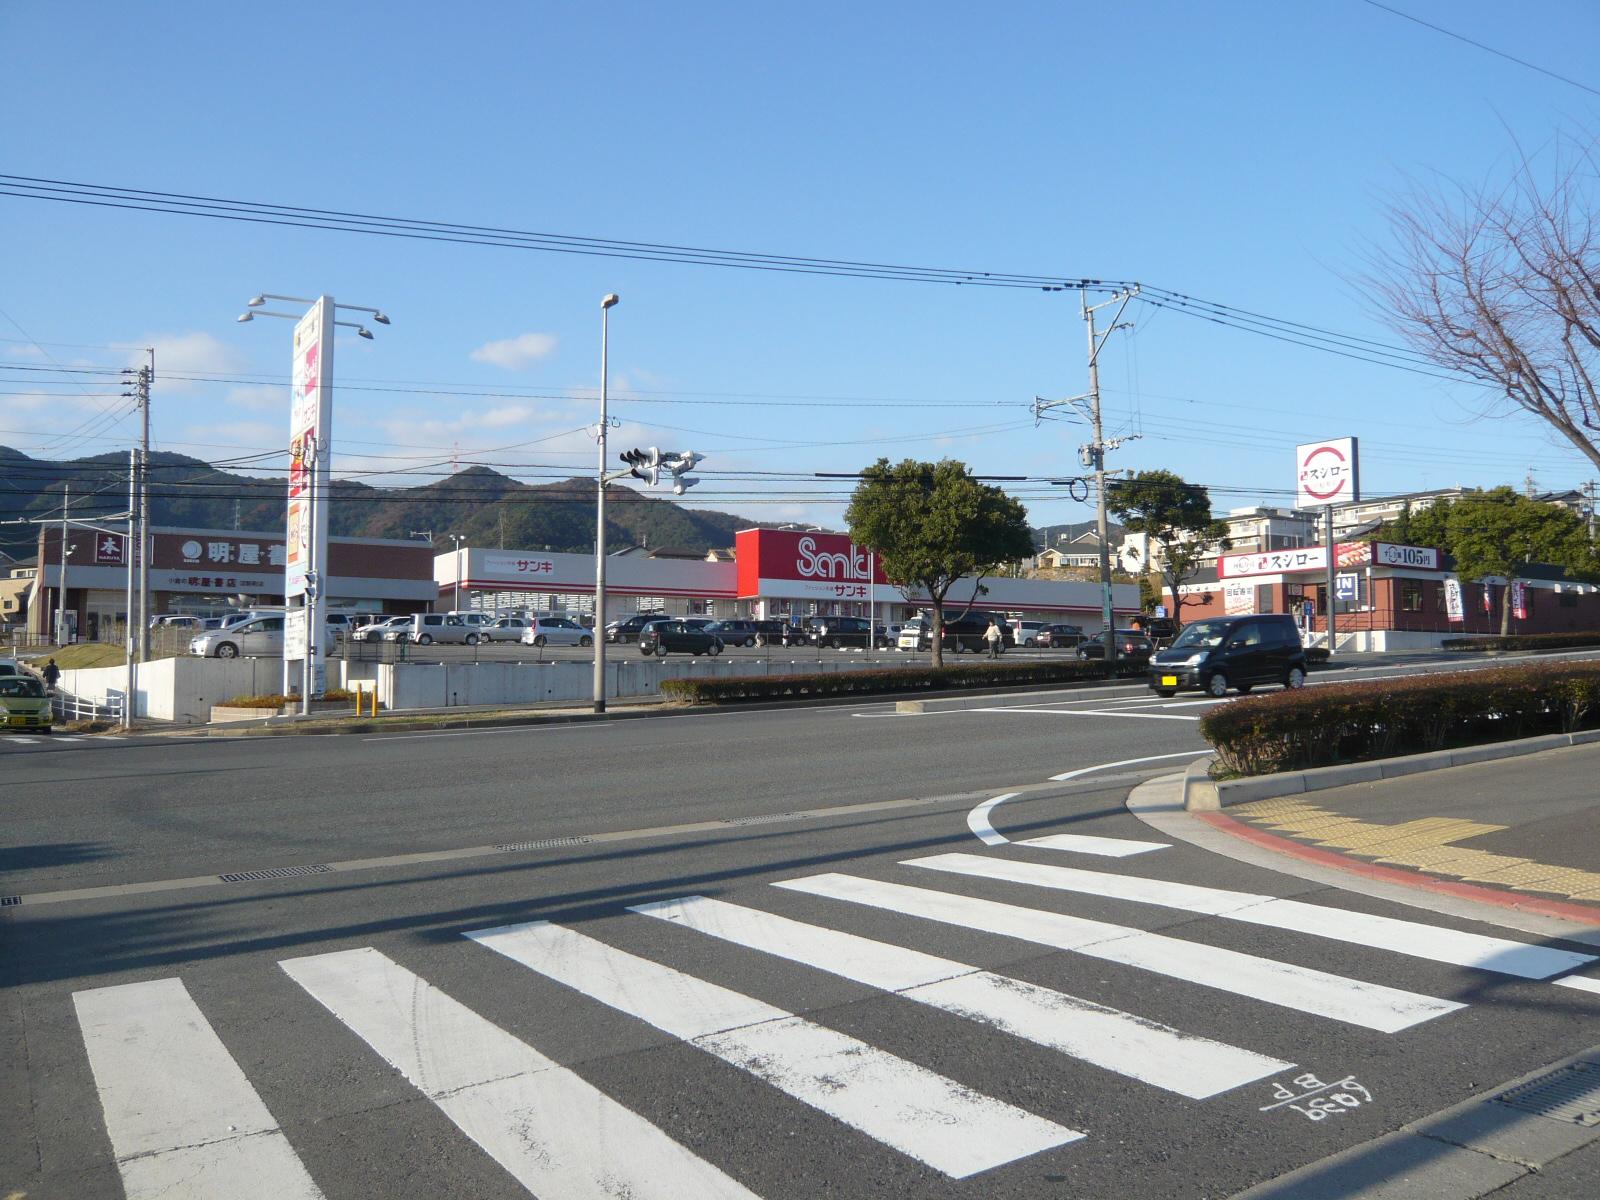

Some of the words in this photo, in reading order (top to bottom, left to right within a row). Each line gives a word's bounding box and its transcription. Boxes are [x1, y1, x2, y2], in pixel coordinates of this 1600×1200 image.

[1309, 466, 1349, 479] スシロー
[100, 537, 120, 555] 本
[796, 536, 870, 580] Sanki
[1271, 553, 1319, 568] スシロー
[517, 560, 553, 573] サンキ
[1336, 577, 1353, 589] IN
[834, 585, 867, 597] サンキ
